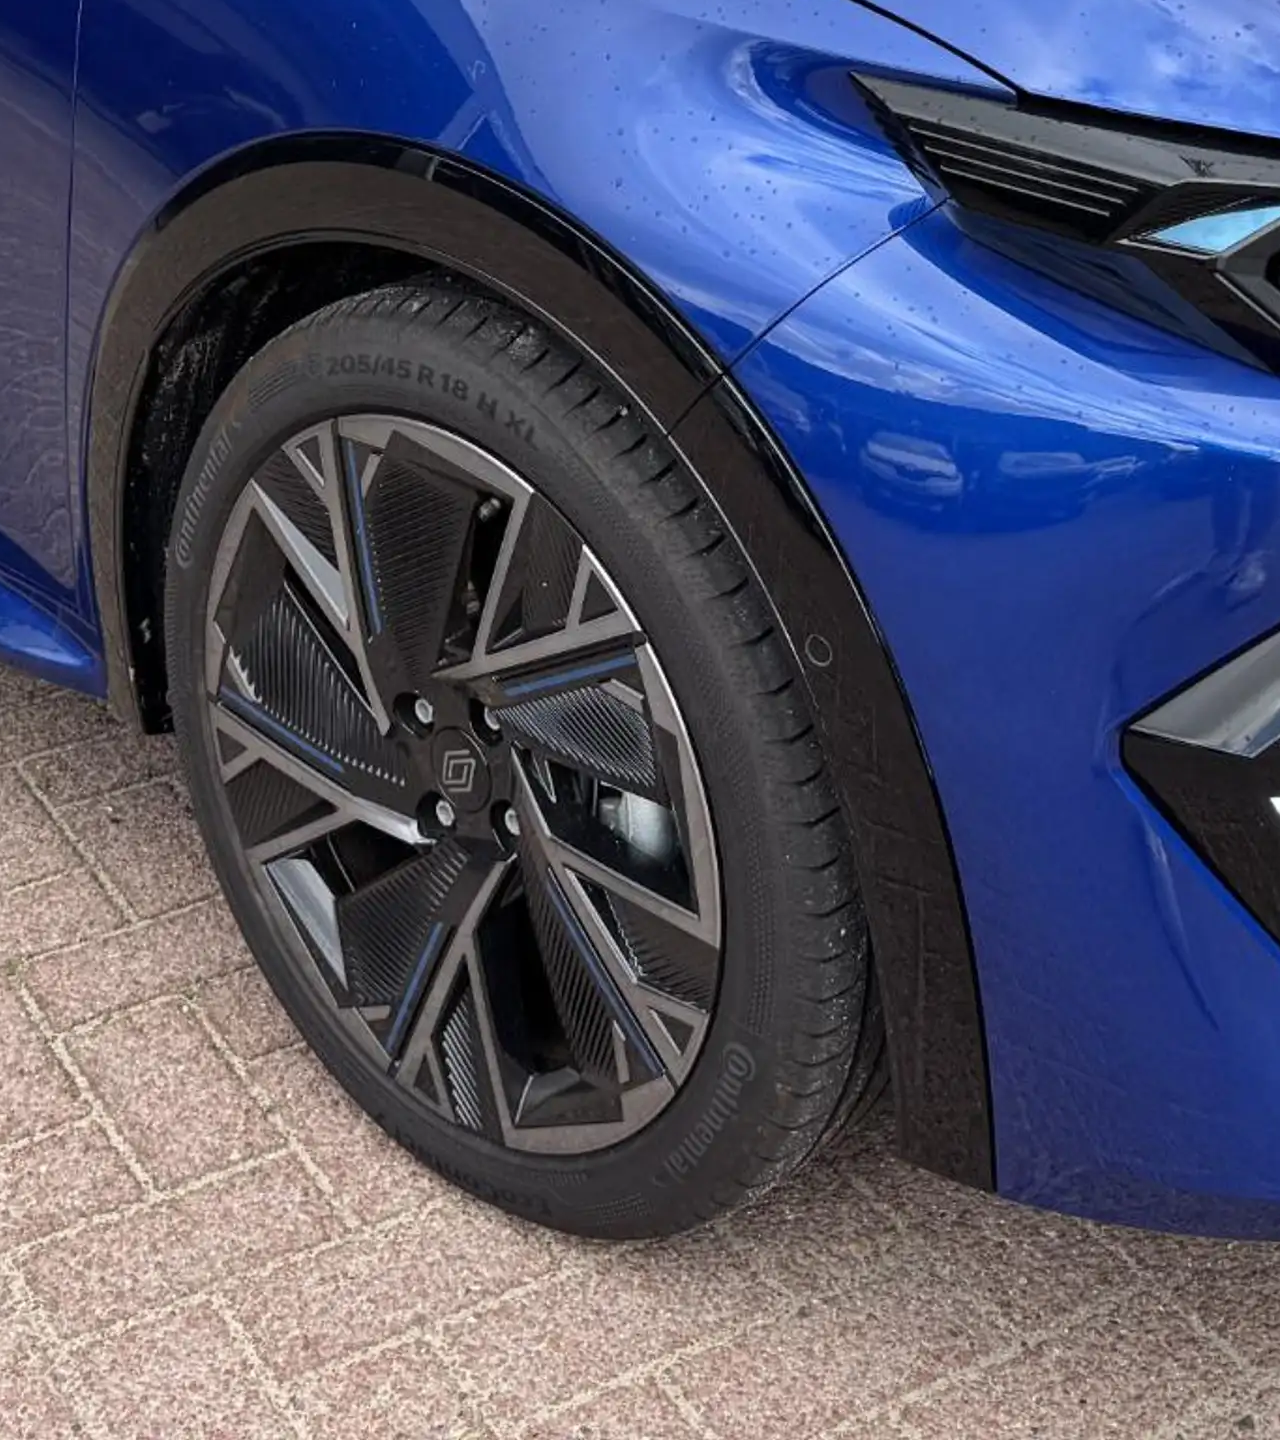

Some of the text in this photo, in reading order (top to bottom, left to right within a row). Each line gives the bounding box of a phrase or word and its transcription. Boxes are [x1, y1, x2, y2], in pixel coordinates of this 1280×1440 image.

[327, 355, 540, 451] 205/45 R 18 H XL
[175, 426, 233, 569] Continental
[664, 1042, 756, 1184] Continental
